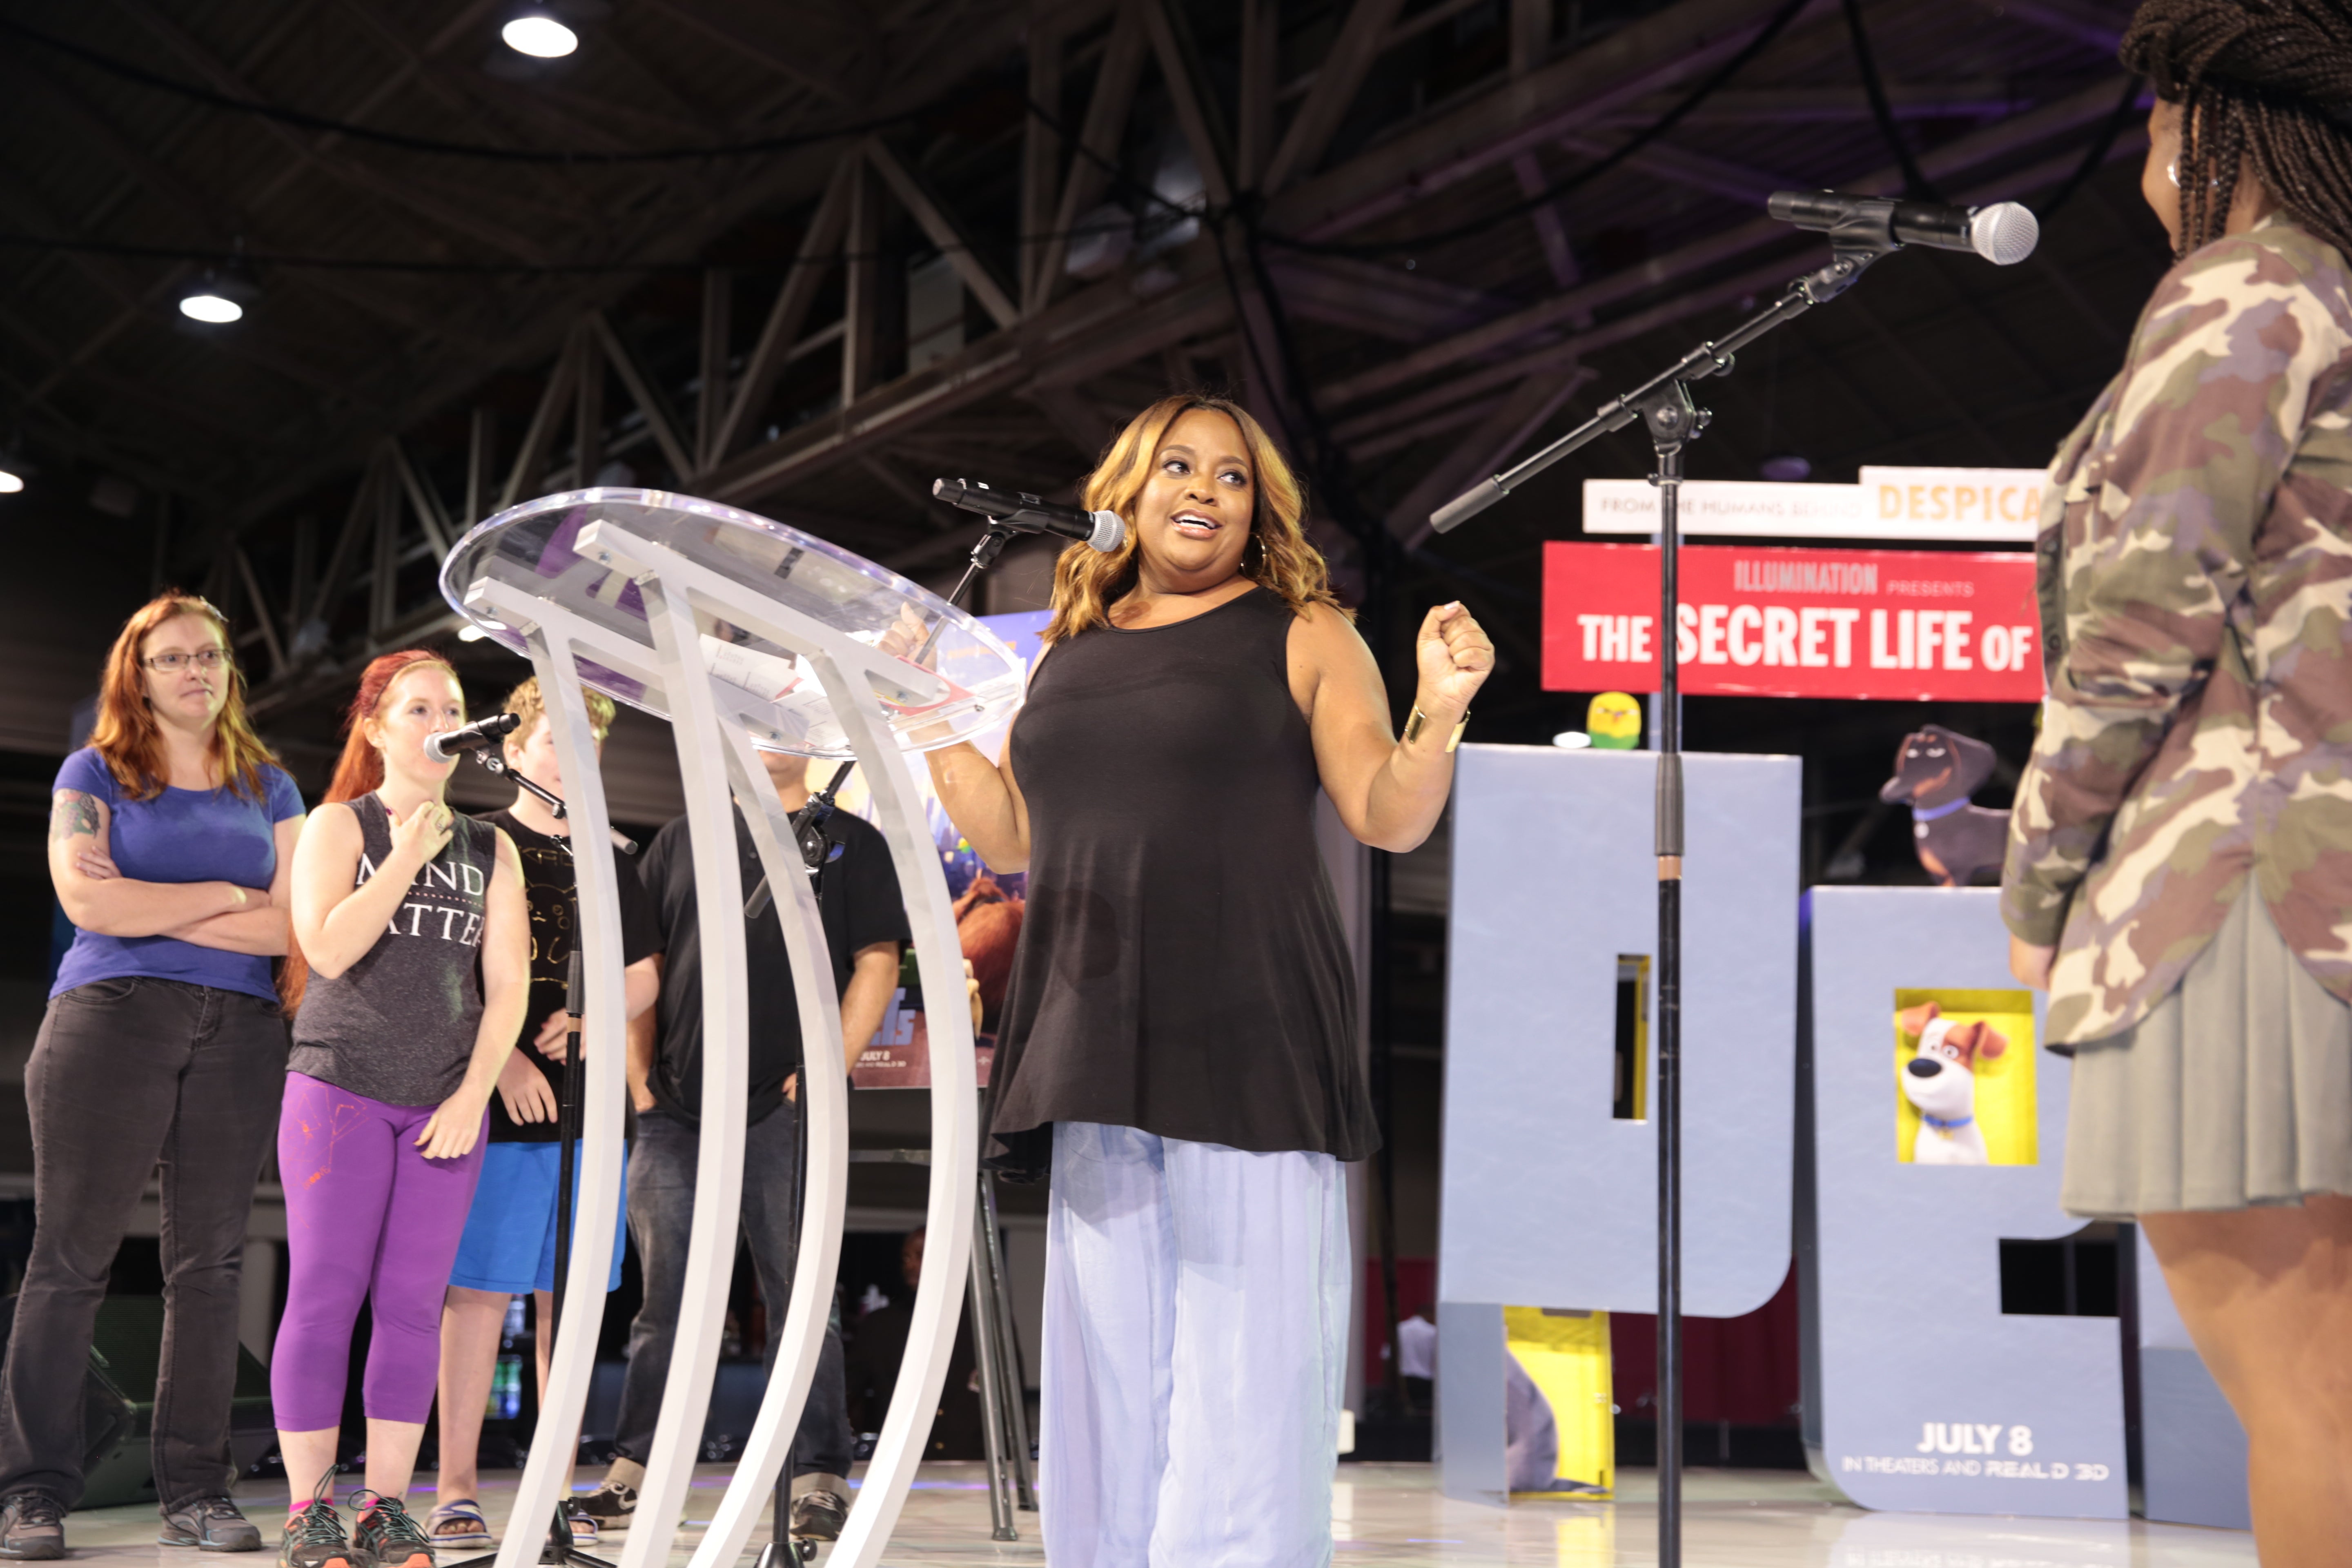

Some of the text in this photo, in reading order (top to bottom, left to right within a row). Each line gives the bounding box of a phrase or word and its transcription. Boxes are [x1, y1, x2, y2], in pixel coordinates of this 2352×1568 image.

[1600, 497, 1655, 514] FROM
[1702, 500, 1785, 516] HUMANS
[1790, 501, 1862, 519] BEHIND
[1879, 484, 2040, 522] DESPICA
[1734, 560, 1975, 597] ILLUMINATION PRESENTS
[1577, 604, 2033, 671] THE SECRET LIFE OF
[356, 853, 484, 896] MND
[1916, 1421, 2034, 1456] JULY 8
[1842, 1456, 1862, 1472] IN
[1864, 1457, 1940, 1475] THEATERS
[1940, 1459, 1981, 1477] AND
[2074, 1463, 2109, 1481] 3D
